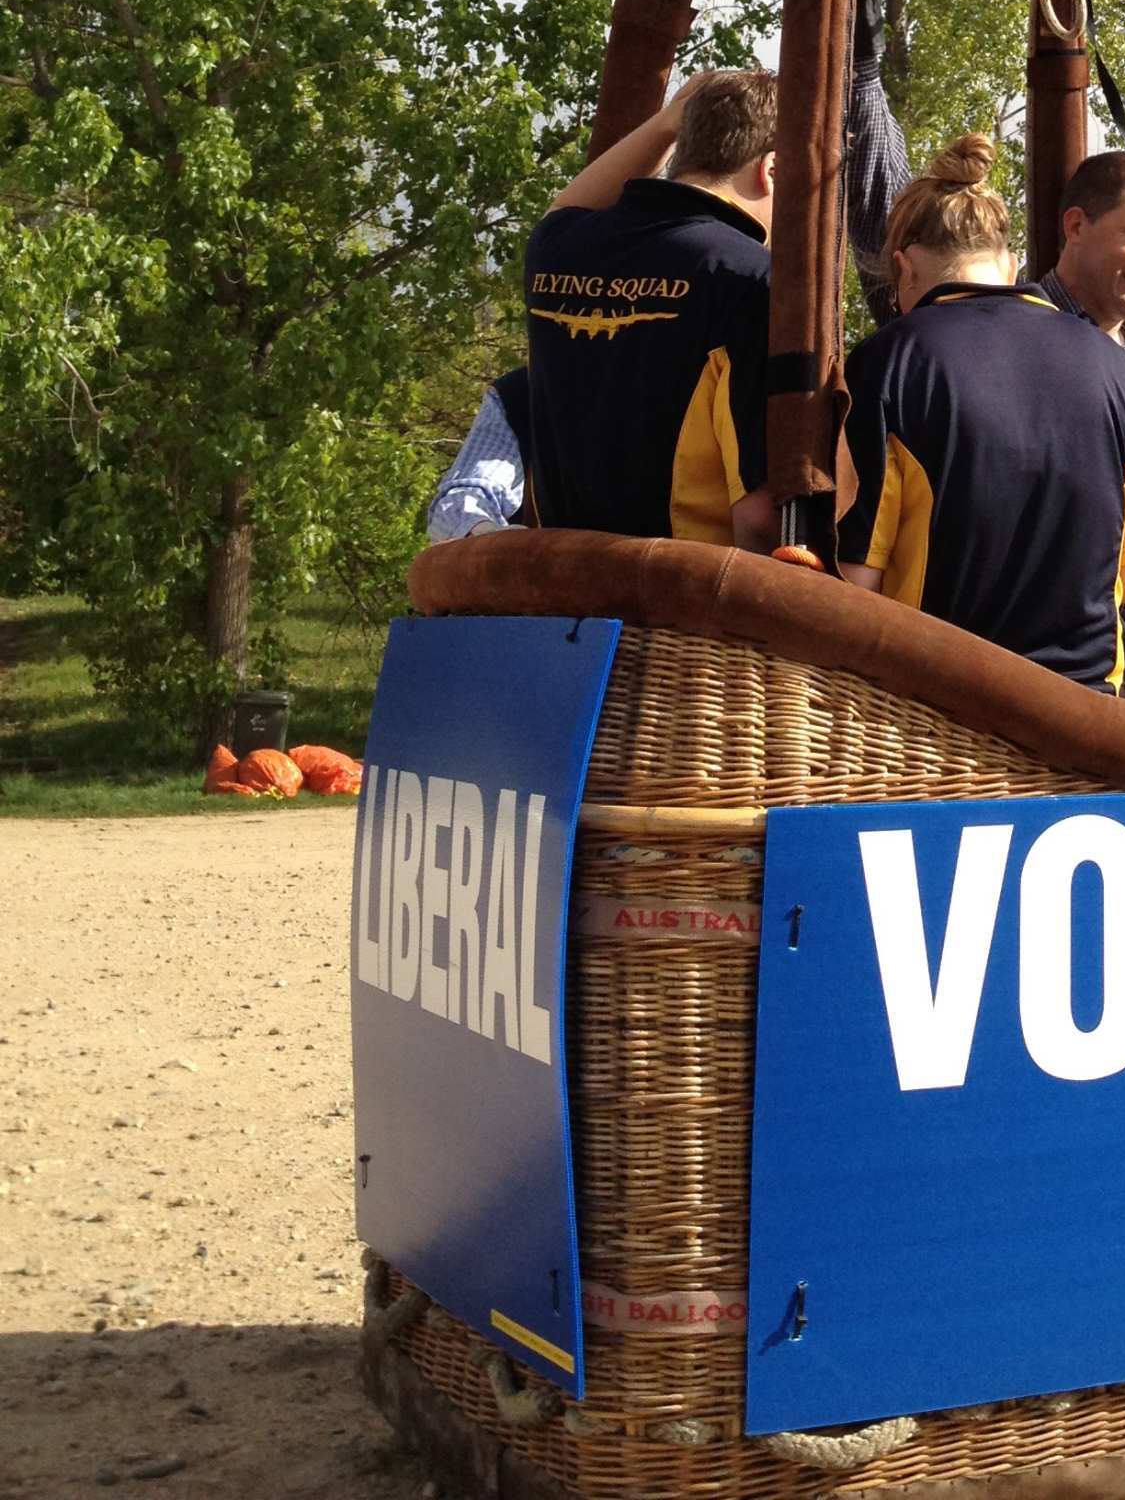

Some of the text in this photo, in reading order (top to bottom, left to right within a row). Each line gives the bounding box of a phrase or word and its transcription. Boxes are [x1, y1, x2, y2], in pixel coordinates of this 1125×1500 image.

[532, 273, 690, 302] FLYING SQUAD
[358, 765, 551, 1066] LIBERAL
